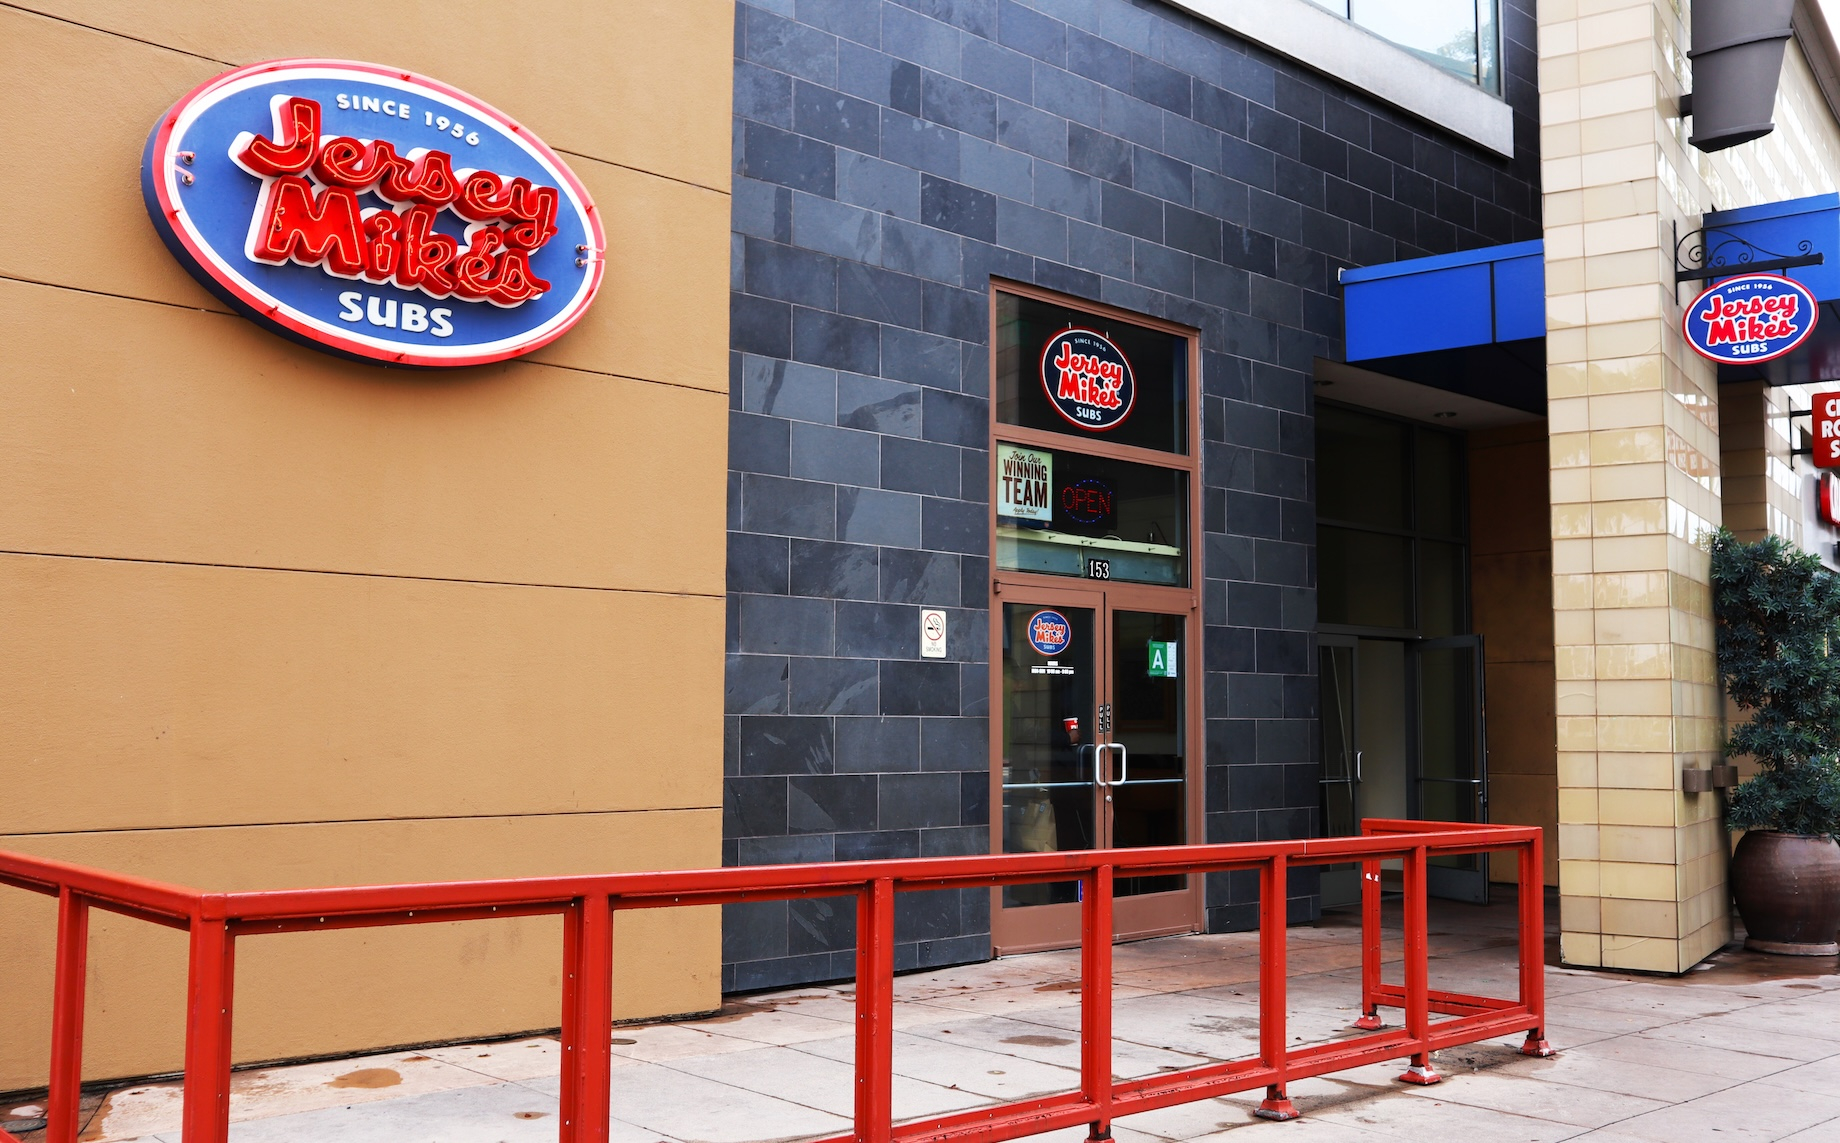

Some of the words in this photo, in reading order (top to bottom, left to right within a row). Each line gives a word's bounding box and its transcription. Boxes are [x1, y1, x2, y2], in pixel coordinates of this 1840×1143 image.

[336, 93, 411, 120] SINCE
[424, 111, 481, 146] 1956
[231, 95, 559, 251] Jersey
[252, 174, 552, 307] Mike's
[1727, 284, 1750, 294] SINCE
[338, 291, 455, 338] SUBS
[1702, 295, 1797, 320] Jersey
[1708, 316, 1797, 345] Mike's
[1093, 341, 1106, 352] 1956
[1732, 343, 1768, 355] SUBS
[1055, 343, 1122, 389] Jersey
[1059, 370, 1121, 408] Mike's
[1076, 406, 1102, 421] SUBS
[1009, 451, 1026, 461] Join
[1028, 453, 1042, 464] Our
[1003, 459, 1047, 481] WINNING
[1003, 476, 1047, 508] TEAM
[1062, 486, 1110, 514] OPEN
[1090, 560, 1110, 579] 153
[1034, 618, 1065, 636] Jersey
[1036, 631, 1065, 644] Mike's
[1152, 649, 1164, 669] A
